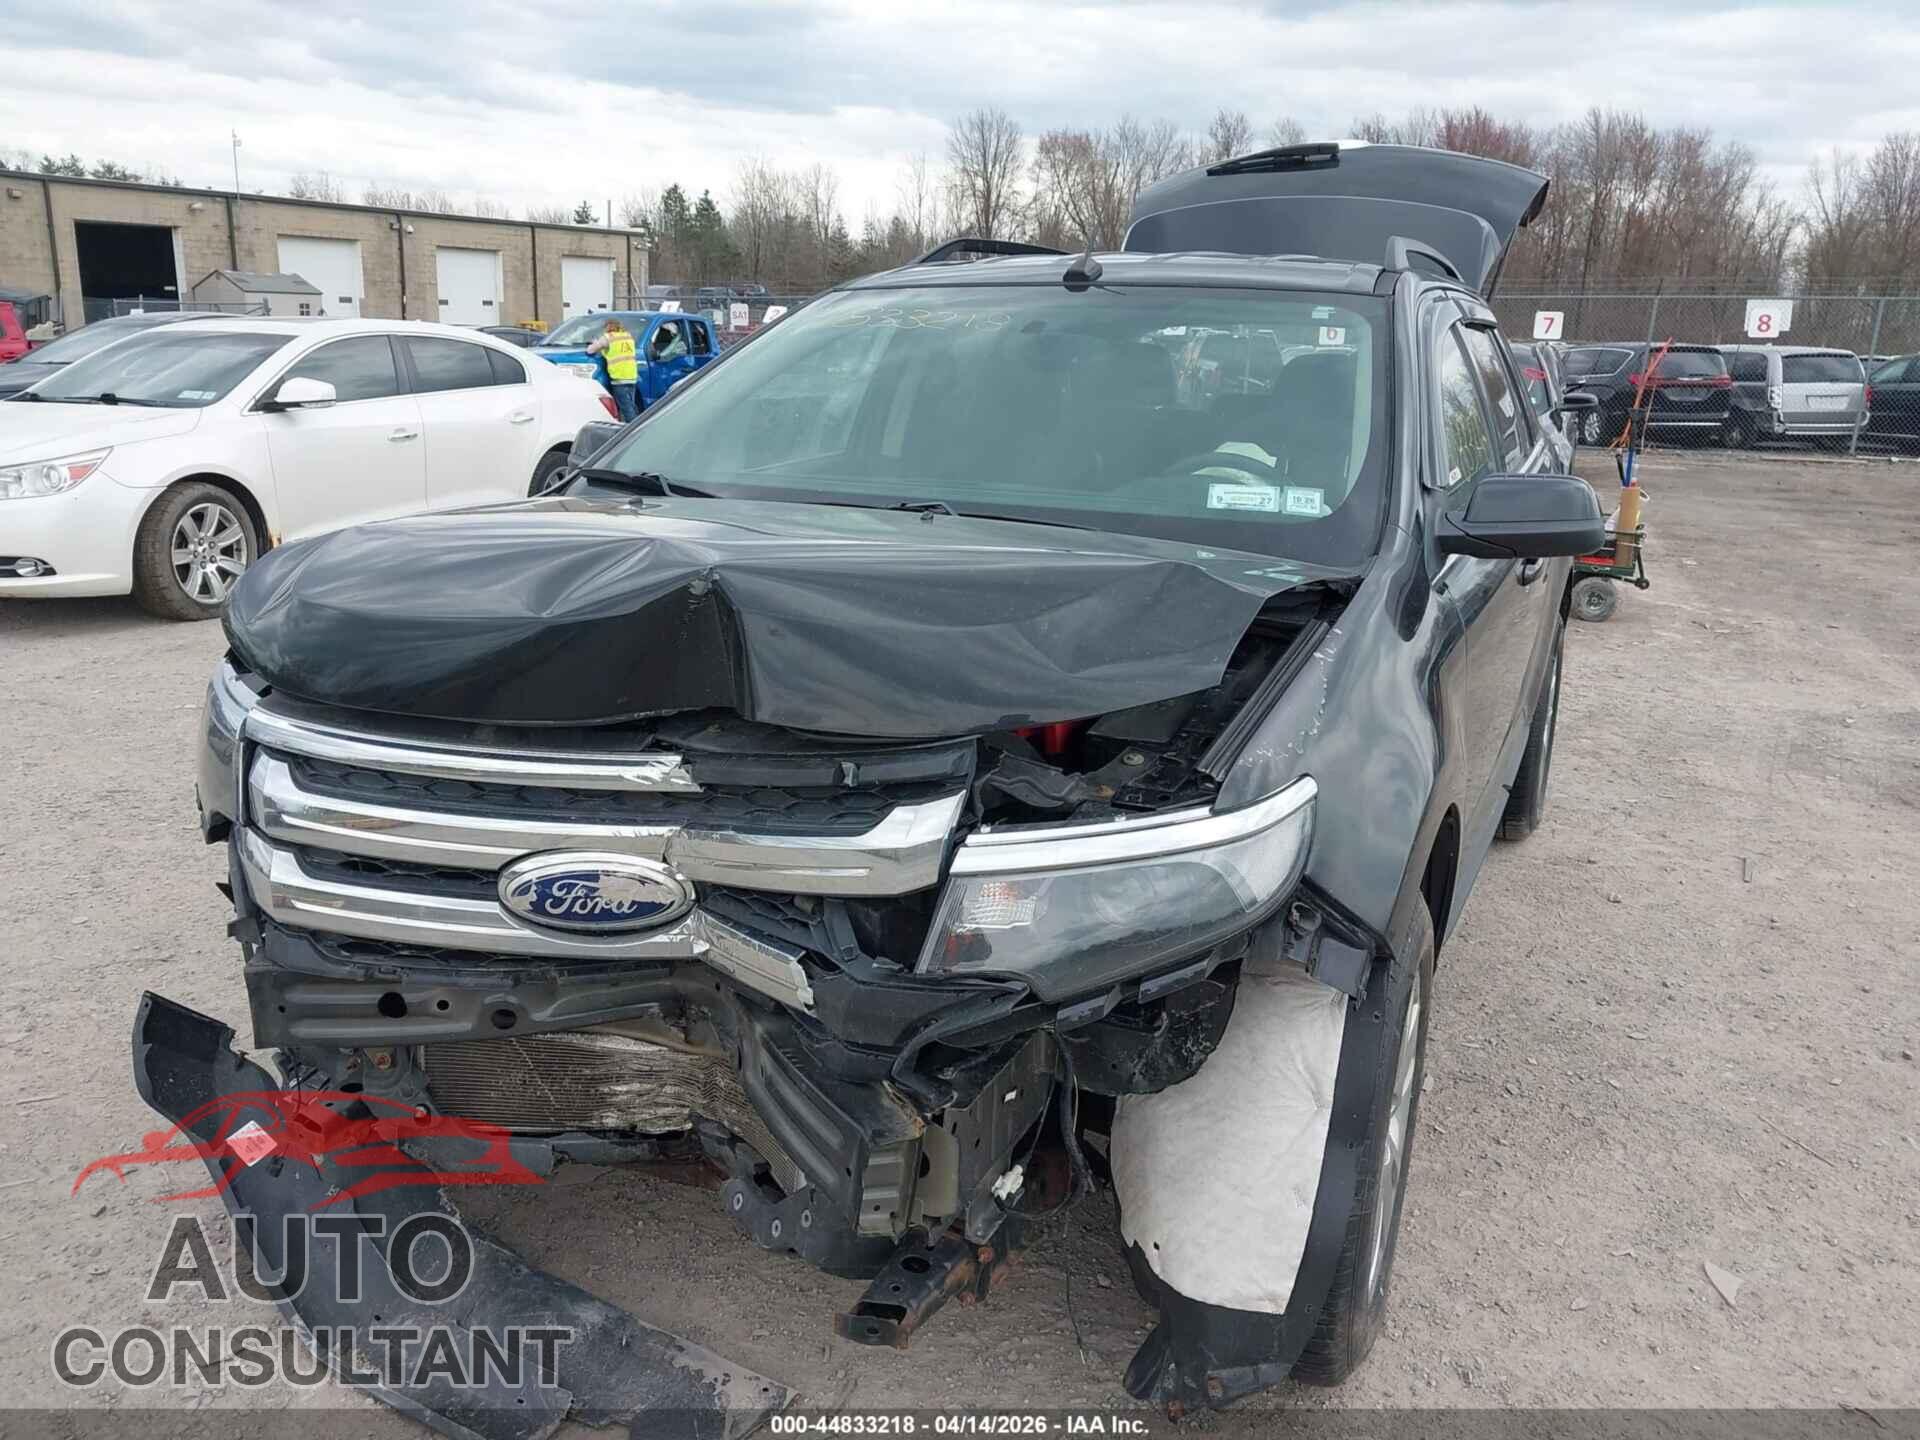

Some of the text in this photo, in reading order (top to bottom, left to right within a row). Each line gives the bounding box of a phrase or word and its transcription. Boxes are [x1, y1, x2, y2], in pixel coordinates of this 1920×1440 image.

[732, 310, 748, 319] SA1
[1757, 313, 1772, 333] 8
[1543, 316, 1555, 335] 7
